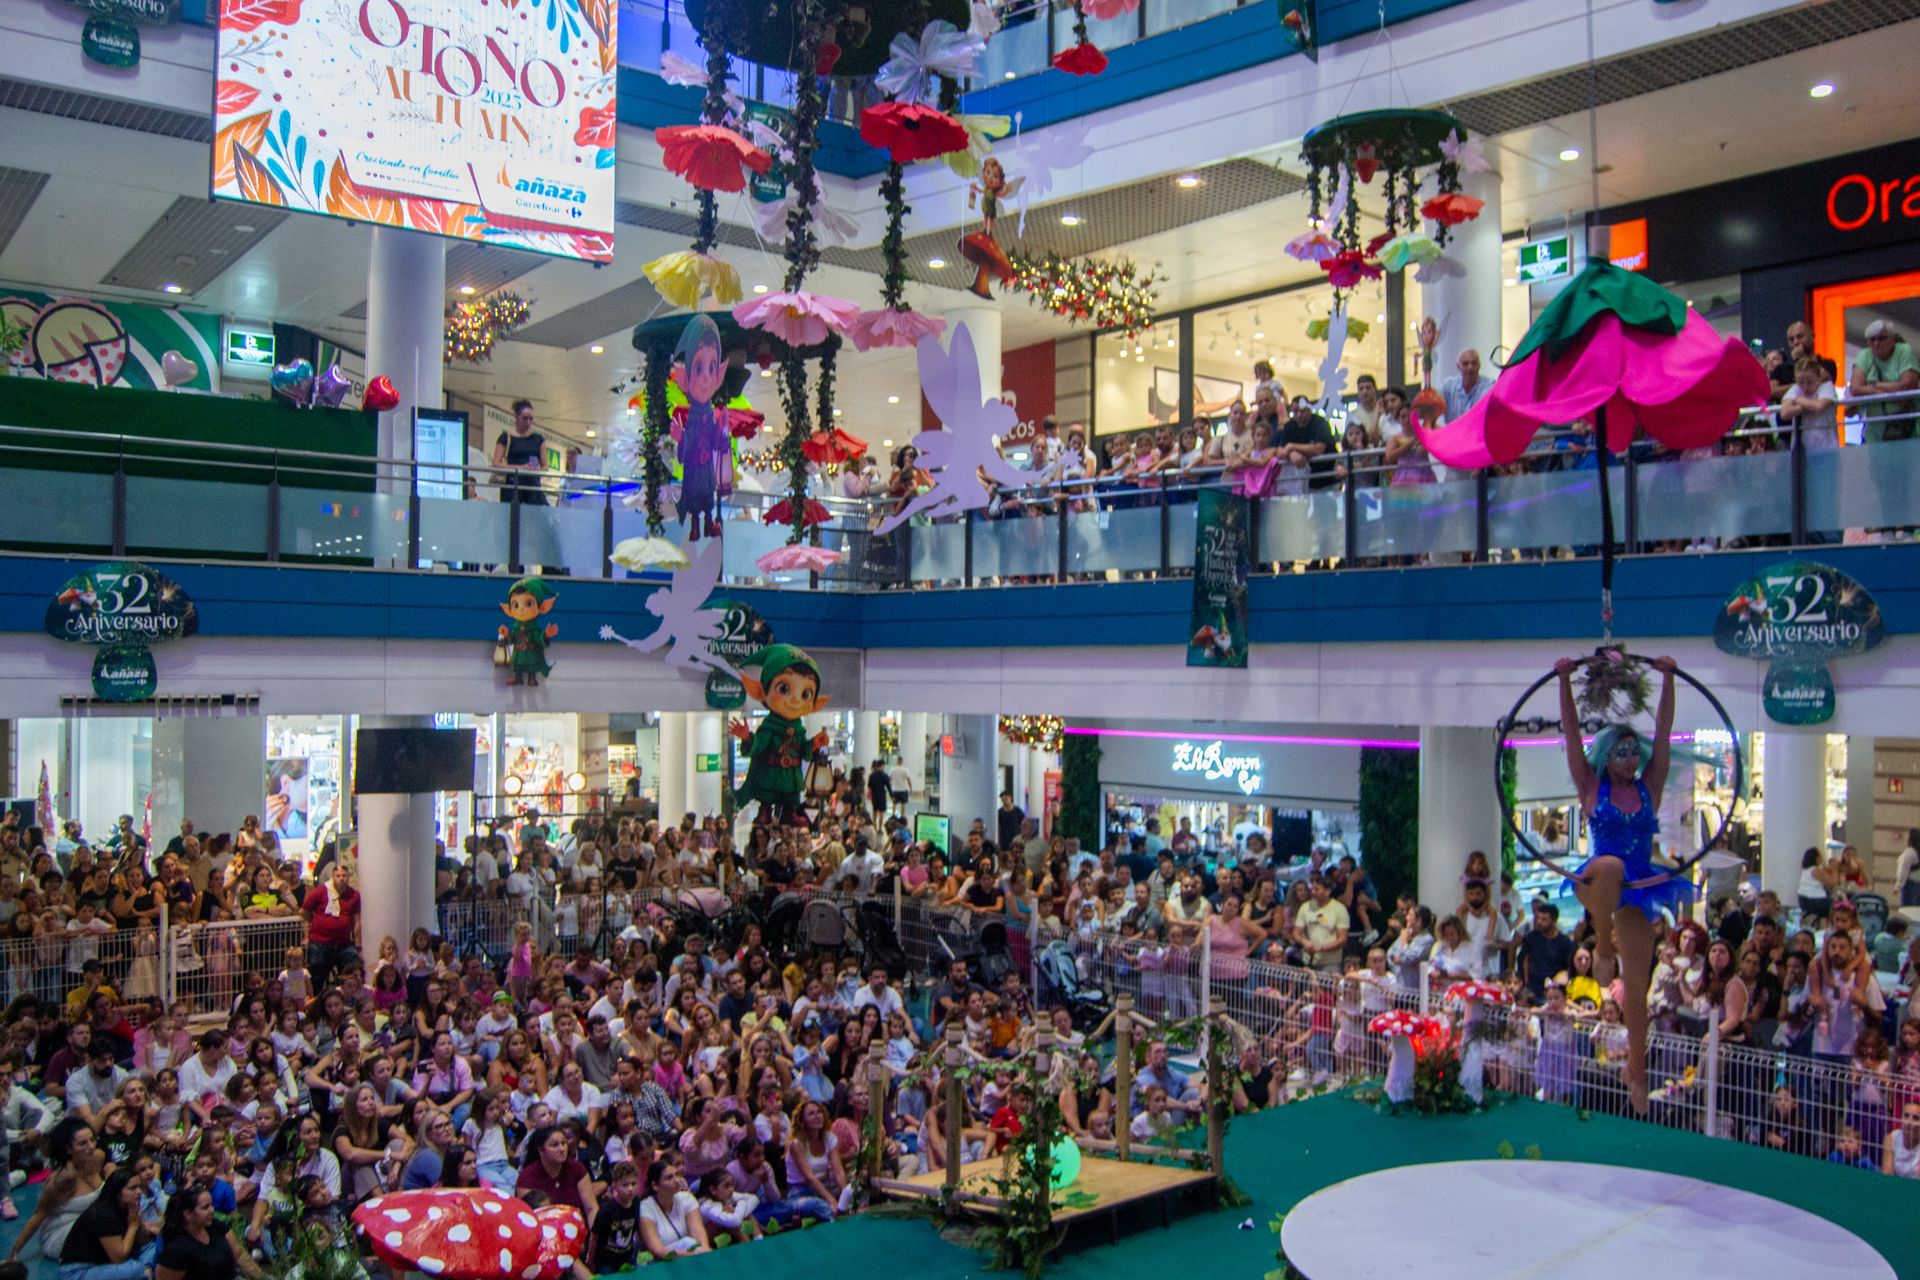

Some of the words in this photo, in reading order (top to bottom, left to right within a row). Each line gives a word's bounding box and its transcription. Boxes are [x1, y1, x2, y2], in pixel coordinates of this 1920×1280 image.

[359, 0, 566, 109] OTOÑO
[480, 88, 523, 110] 2025
[515, 176, 587, 204] añaza
[96, 573, 151, 613] 32
[1766, 574, 1828, 623] 32
[65, 612, 178, 643] Aniversario
[1734, 619, 1860, 656] Aniversario
